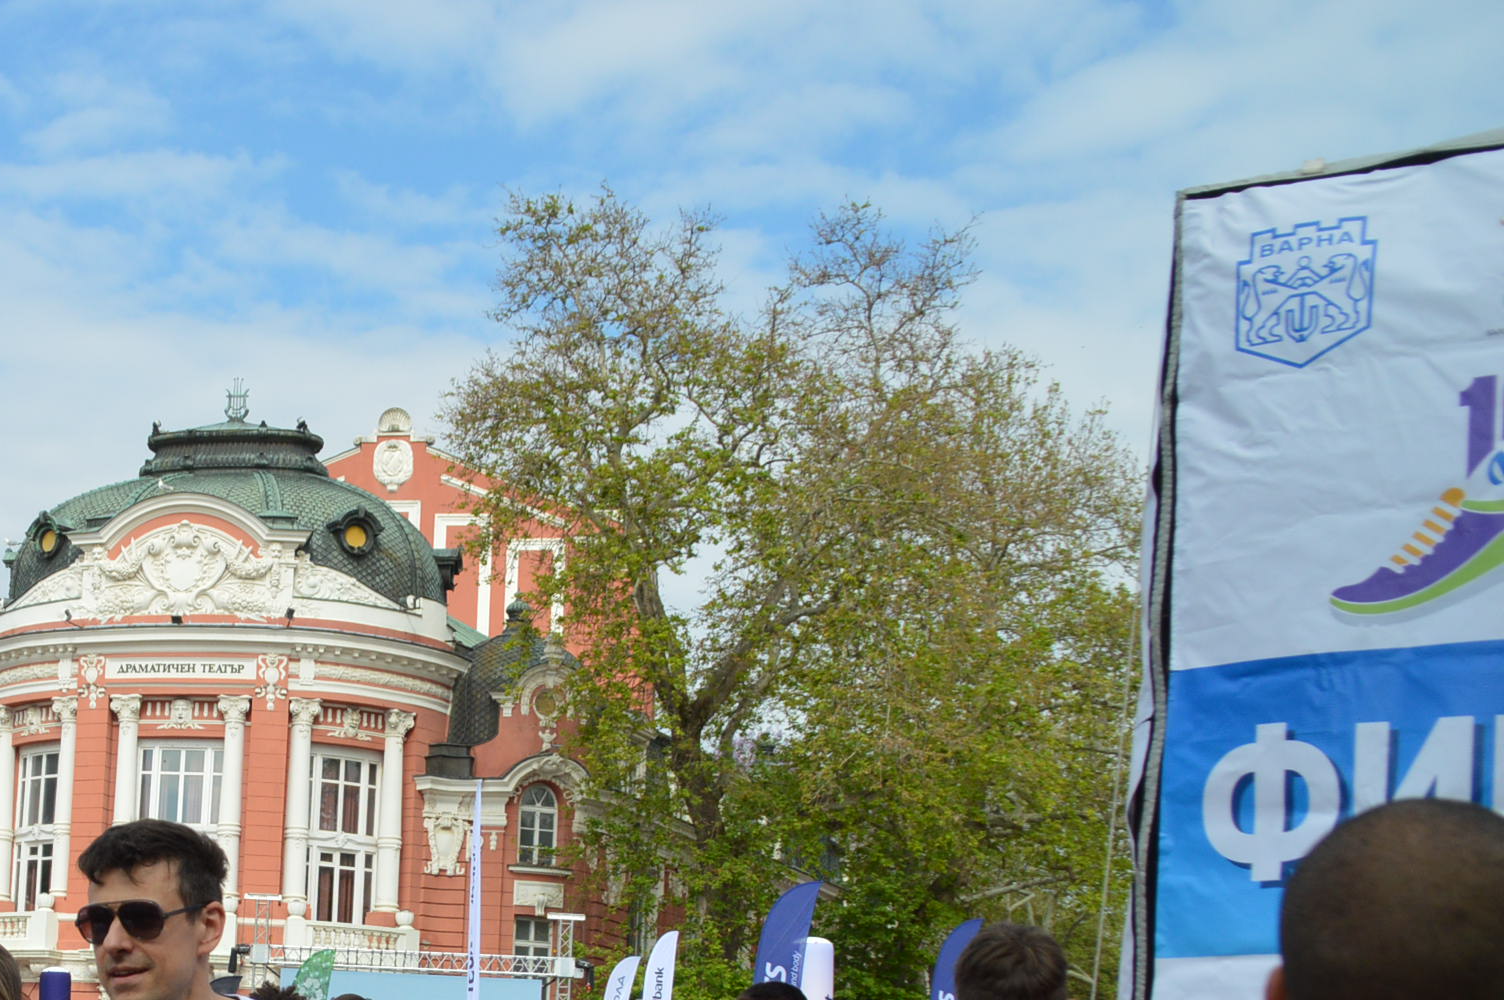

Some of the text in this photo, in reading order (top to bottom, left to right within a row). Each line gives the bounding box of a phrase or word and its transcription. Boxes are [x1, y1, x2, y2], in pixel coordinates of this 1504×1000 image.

[1259, 231, 1354, 258] ВАРНА
[1459, 374, 1504, 478] 1
[117, 663, 245, 674] ДРАМАТИЧЕН ТЕАТЪР
[1202, 715, 1504, 882] ФИ
